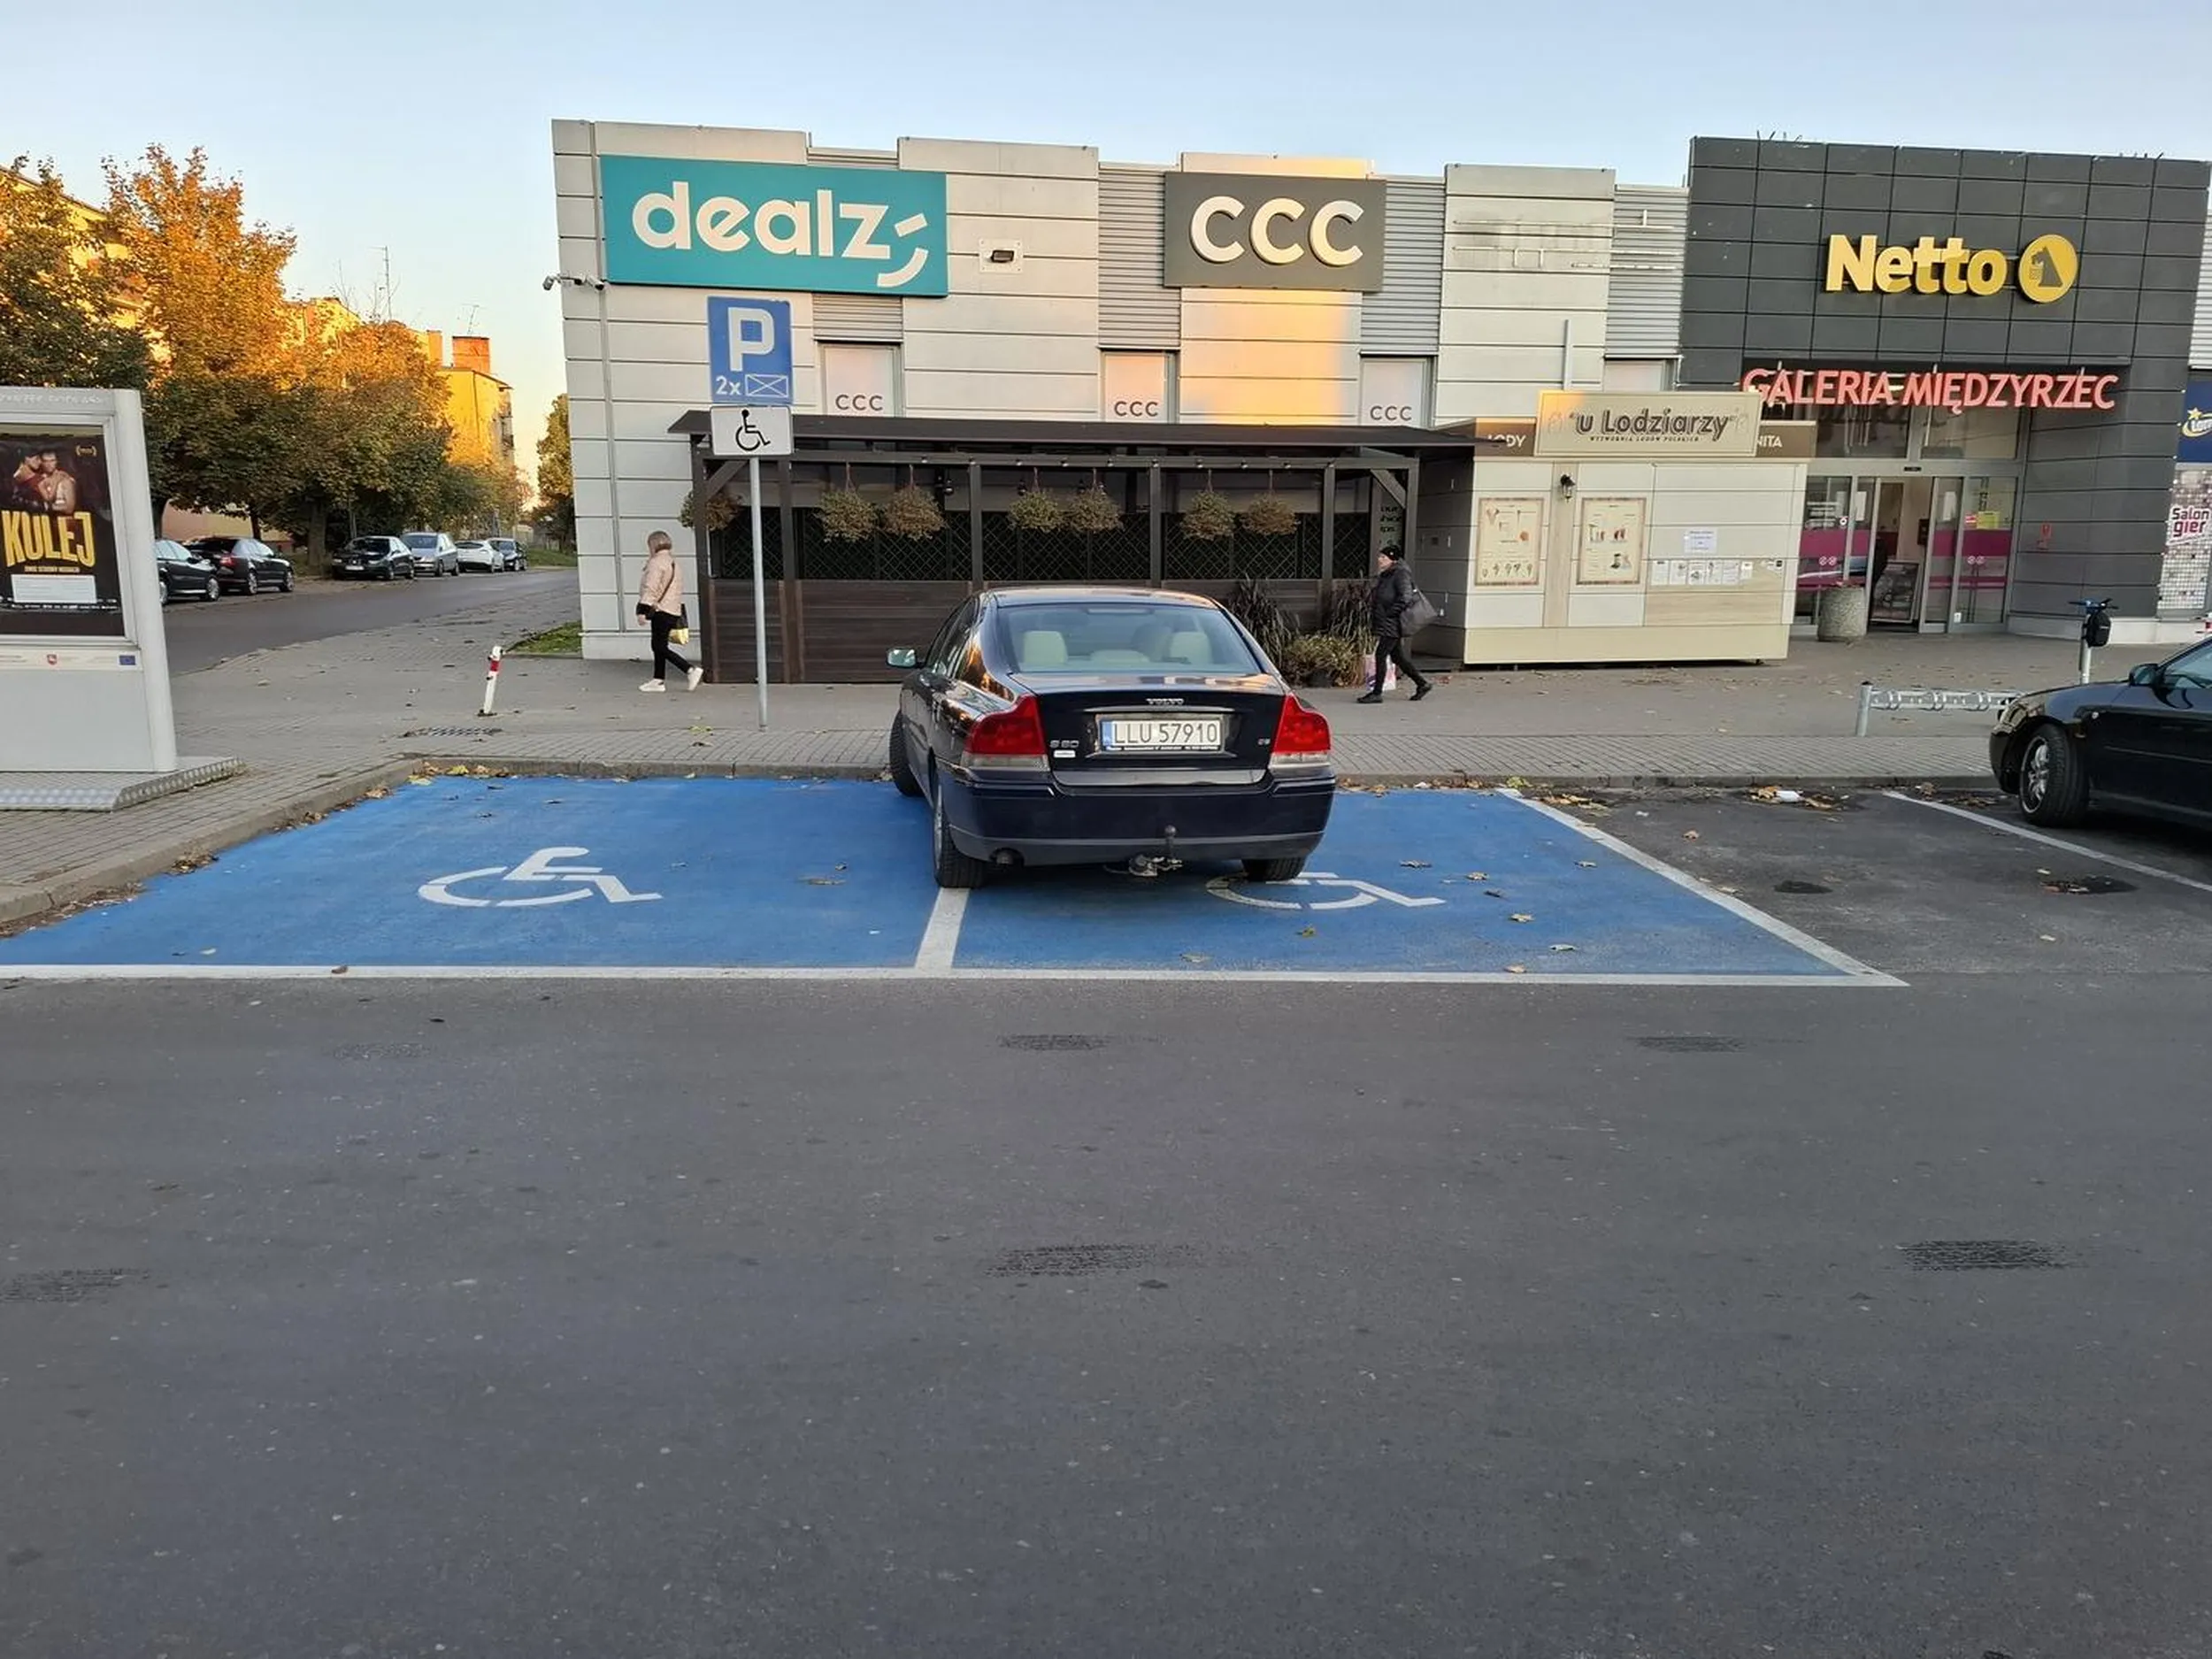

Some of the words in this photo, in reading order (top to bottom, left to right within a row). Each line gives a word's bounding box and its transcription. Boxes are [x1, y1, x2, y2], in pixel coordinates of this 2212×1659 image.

[632, 180, 892, 260] dealz
[1189, 196, 1364, 267] CCC
[1825, 234, 2008, 296] Netto
[728, 306, 774, 372] P
[716, 375, 741, 396] 2x
[1742, 367, 1894, 406] GALERIA
[1901, 371, 2119, 414] MIĘDZYRZEC
[835, 394, 883, 411] CCC
[1114, 401, 1158, 417] CCC
[1370, 405, 1412, 422] CCC
[2172, 507, 2209, 520] Salon
[2, 510, 96, 567] KULEJ
[2173, 520, 2207, 537] gier
[1114, 723, 1152, 743] LLU
[1159, 723, 1217, 743] 57910
